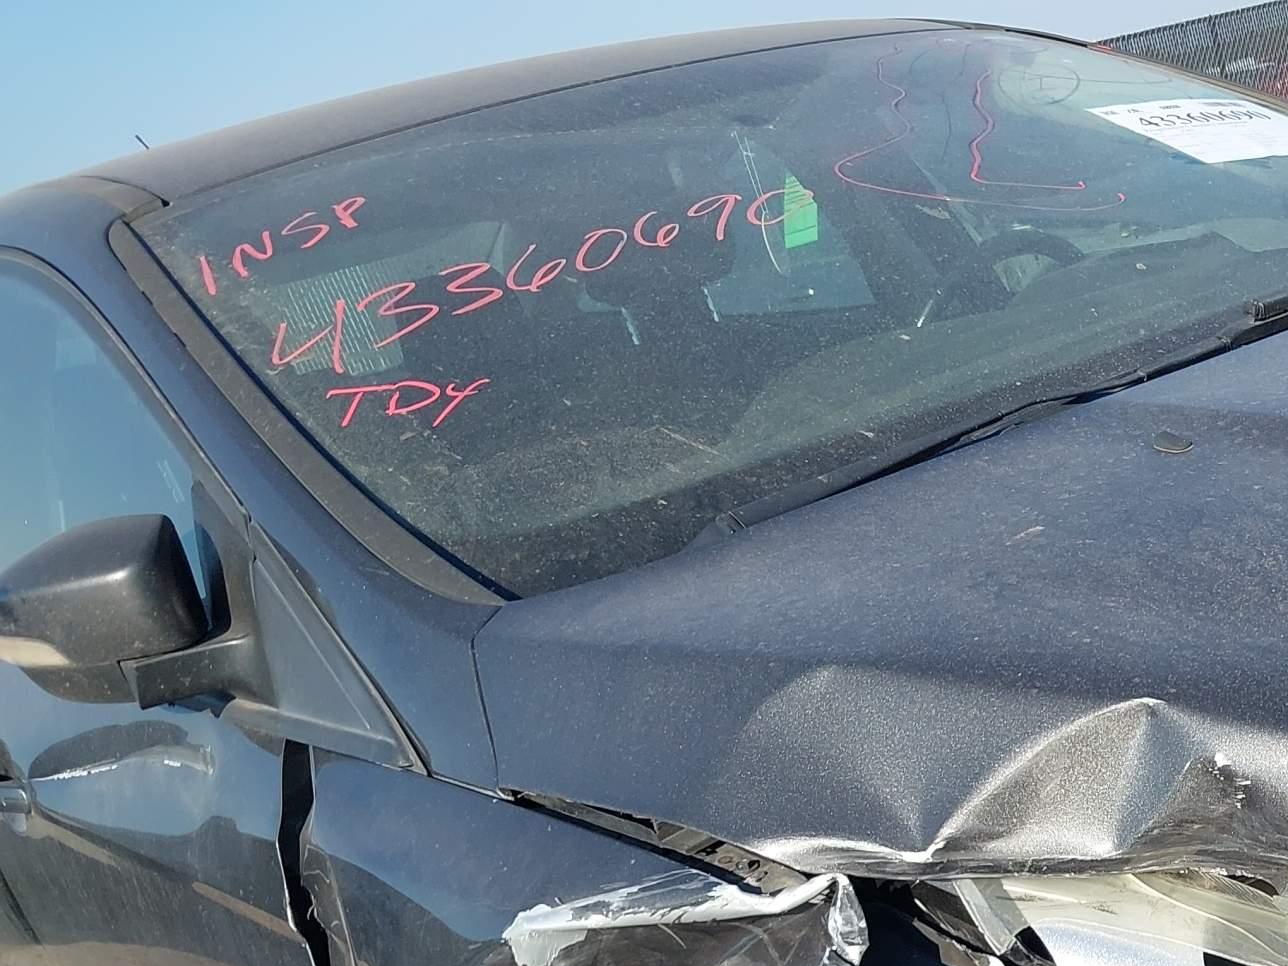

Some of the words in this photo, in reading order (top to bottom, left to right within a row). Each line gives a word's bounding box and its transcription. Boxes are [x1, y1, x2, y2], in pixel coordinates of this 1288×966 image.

[1138, 109, 1272, 128] 43360690
[199, 197, 366, 295] INSP
[271, 188, 814, 373] 43360690
